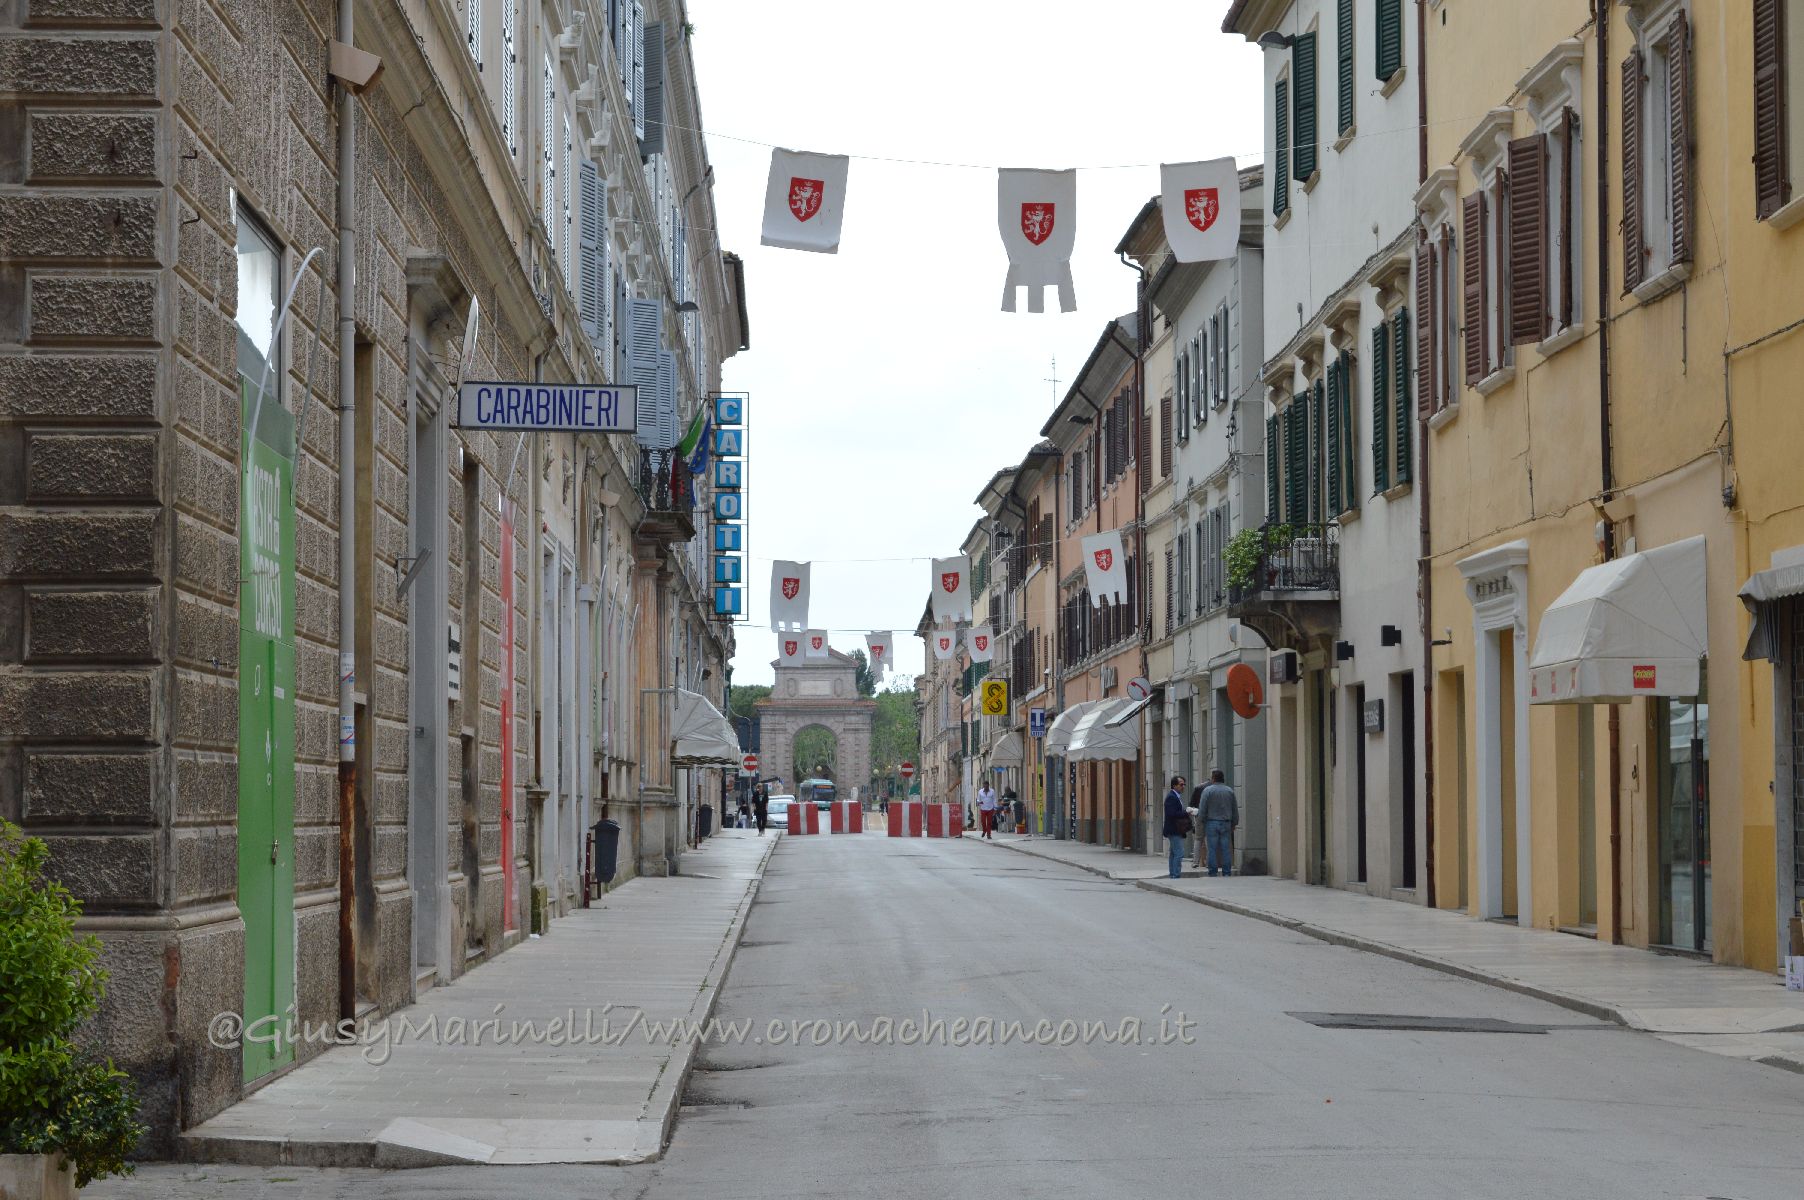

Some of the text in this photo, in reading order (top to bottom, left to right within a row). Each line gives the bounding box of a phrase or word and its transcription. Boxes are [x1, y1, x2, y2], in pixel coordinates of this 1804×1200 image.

[477, 387, 619, 427] CARABINIERI
[719, 401, 738, 611] CAROTTI
[1031, 708, 1044, 726] T
